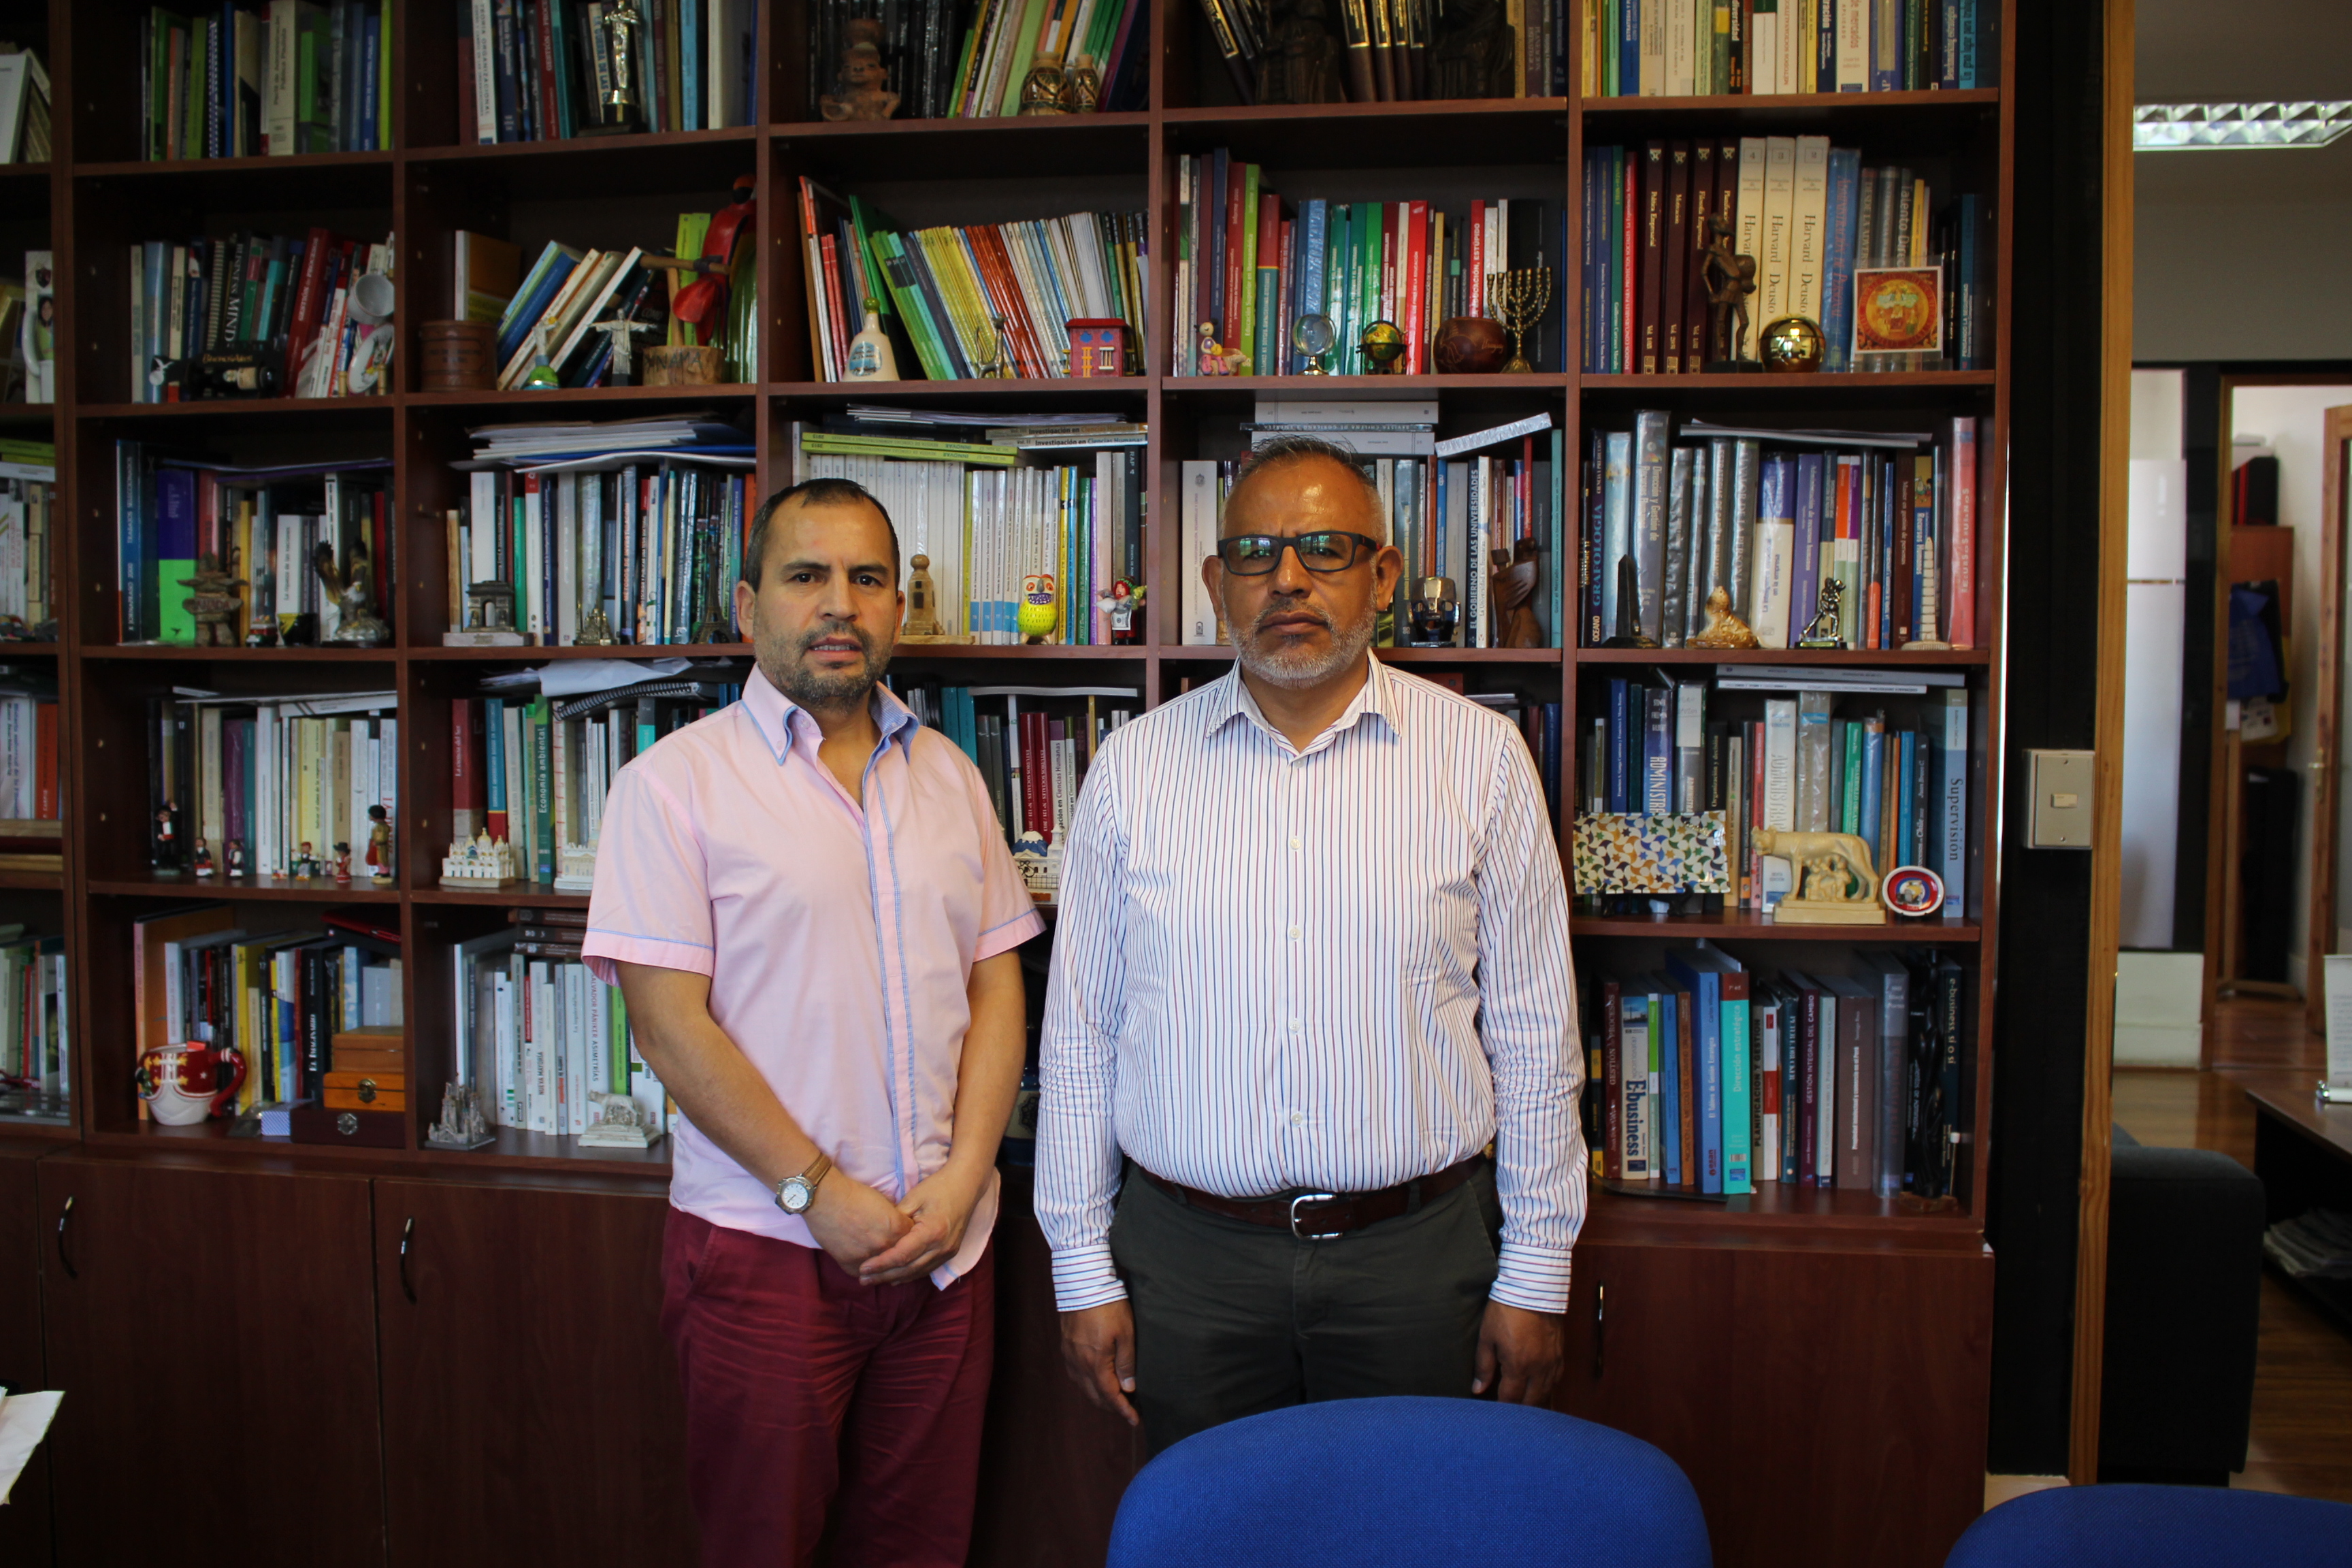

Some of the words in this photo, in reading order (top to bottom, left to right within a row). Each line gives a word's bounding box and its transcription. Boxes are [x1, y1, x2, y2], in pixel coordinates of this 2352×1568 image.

[1851, 10, 1861, 48] mercados
[1961, 37, 1974, 53] lugar
[1963, 21, 1974, 34] para
[1963, 55, 1974, 69] gran
[1899, 185, 1913, 230] Talento
[1472, 223, 1480, 260] ESTÚPIDO
[1744, 215, 1756, 256] Harvar
[1769, 216, 1783, 263] Harvard
[1802, 215, 1816, 262] Harvard
[1245, 280, 1254, 306] Superior
[1768, 274, 1780, 314] Deusto
[1800, 273, 1812, 313] Deusto
[1028, 426, 1071, 434] Investigación
[1034, 439, 1076, 447] Investigación
[1088, 438, 1111, 446] Ciencias
[1649, 466, 1662, 495] Dirección
[1470, 470, 1479, 537] UNIVERSIDADES
[1648, 504, 1661, 530] Gestión
[1470, 539, 1479, 556] LAS
[1470, 558, 1479, 568] DE
[1592, 504, 1603, 606] GRAFOLOGÍA
[1735, 536, 1745, 583] PERSONA
[1469, 570, 1479, 617] GOBIERNO
[1592, 616, 1601, 642] OCEANO
[538, 727, 546, 770] ambiental
[1711, 735, 1719, 761] decisión
[538, 773, 546, 814] Economía
[1650, 755, 1667, 813] ADMINISTRA
[1711, 767, 1720, 807] Organización
[1949, 778, 1964, 862] Supervisión
[591, 974, 600, 1007] SALVADOR
[1807, 995, 1815, 1023] CAMBIO
[591, 1009, 600, 1038] PÁNIKER
[1734, 1005, 1743, 1052] estratégica
[537, 1051, 545, 1076] MAYORÍA
[591, 1040, 600, 1082] ASIMETRÍAS
[1708, 1038, 1717, 1064] Estratégica
[1806, 1039, 1814, 1073] INTEGRAL
[1734, 1054, 1742, 1092] Dirección
[1806, 1075, 1814, 1105] GESTIÓN
